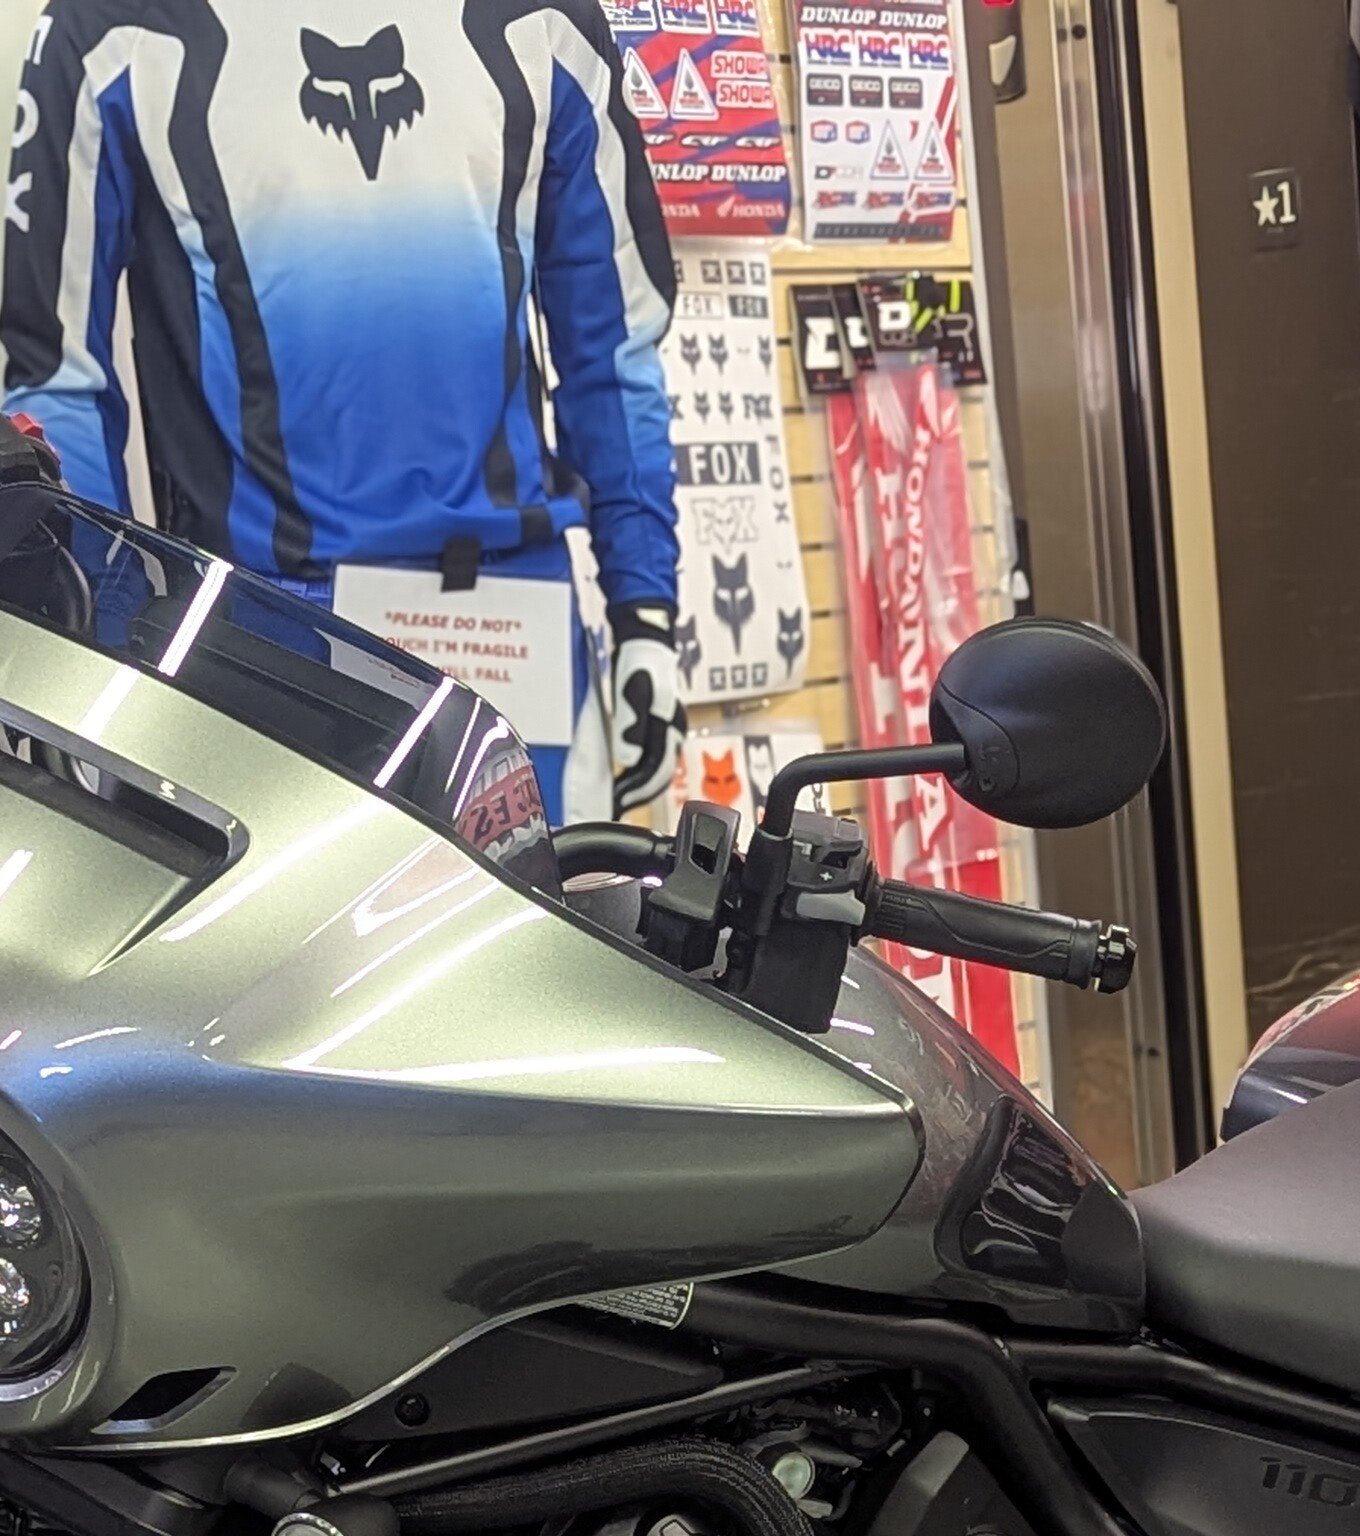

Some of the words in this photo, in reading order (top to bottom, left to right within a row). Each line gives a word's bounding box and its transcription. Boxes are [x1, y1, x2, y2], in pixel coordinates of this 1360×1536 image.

[801, 6, 876, 25] DUNLOP
[879, 10, 948, 29] DUNLOP
[805, 32, 852, 58] HRC
[858, 35, 902, 60] HRC
[908, 37, 950, 63] HRC
[711, 164, 786, 182] DUNLOP
[733, 205, 785, 218] HONDA
[682, 294, 713, 315] FOX
[689, 444, 752, 484] FOX
[454, 616, 477, 630] DO
[385, 637, 428, 651] OUCH
[433, 640, 458, 653] I'M
[463, 642, 528, 659] FRAGILE
[475, 667, 512, 683] FALL
